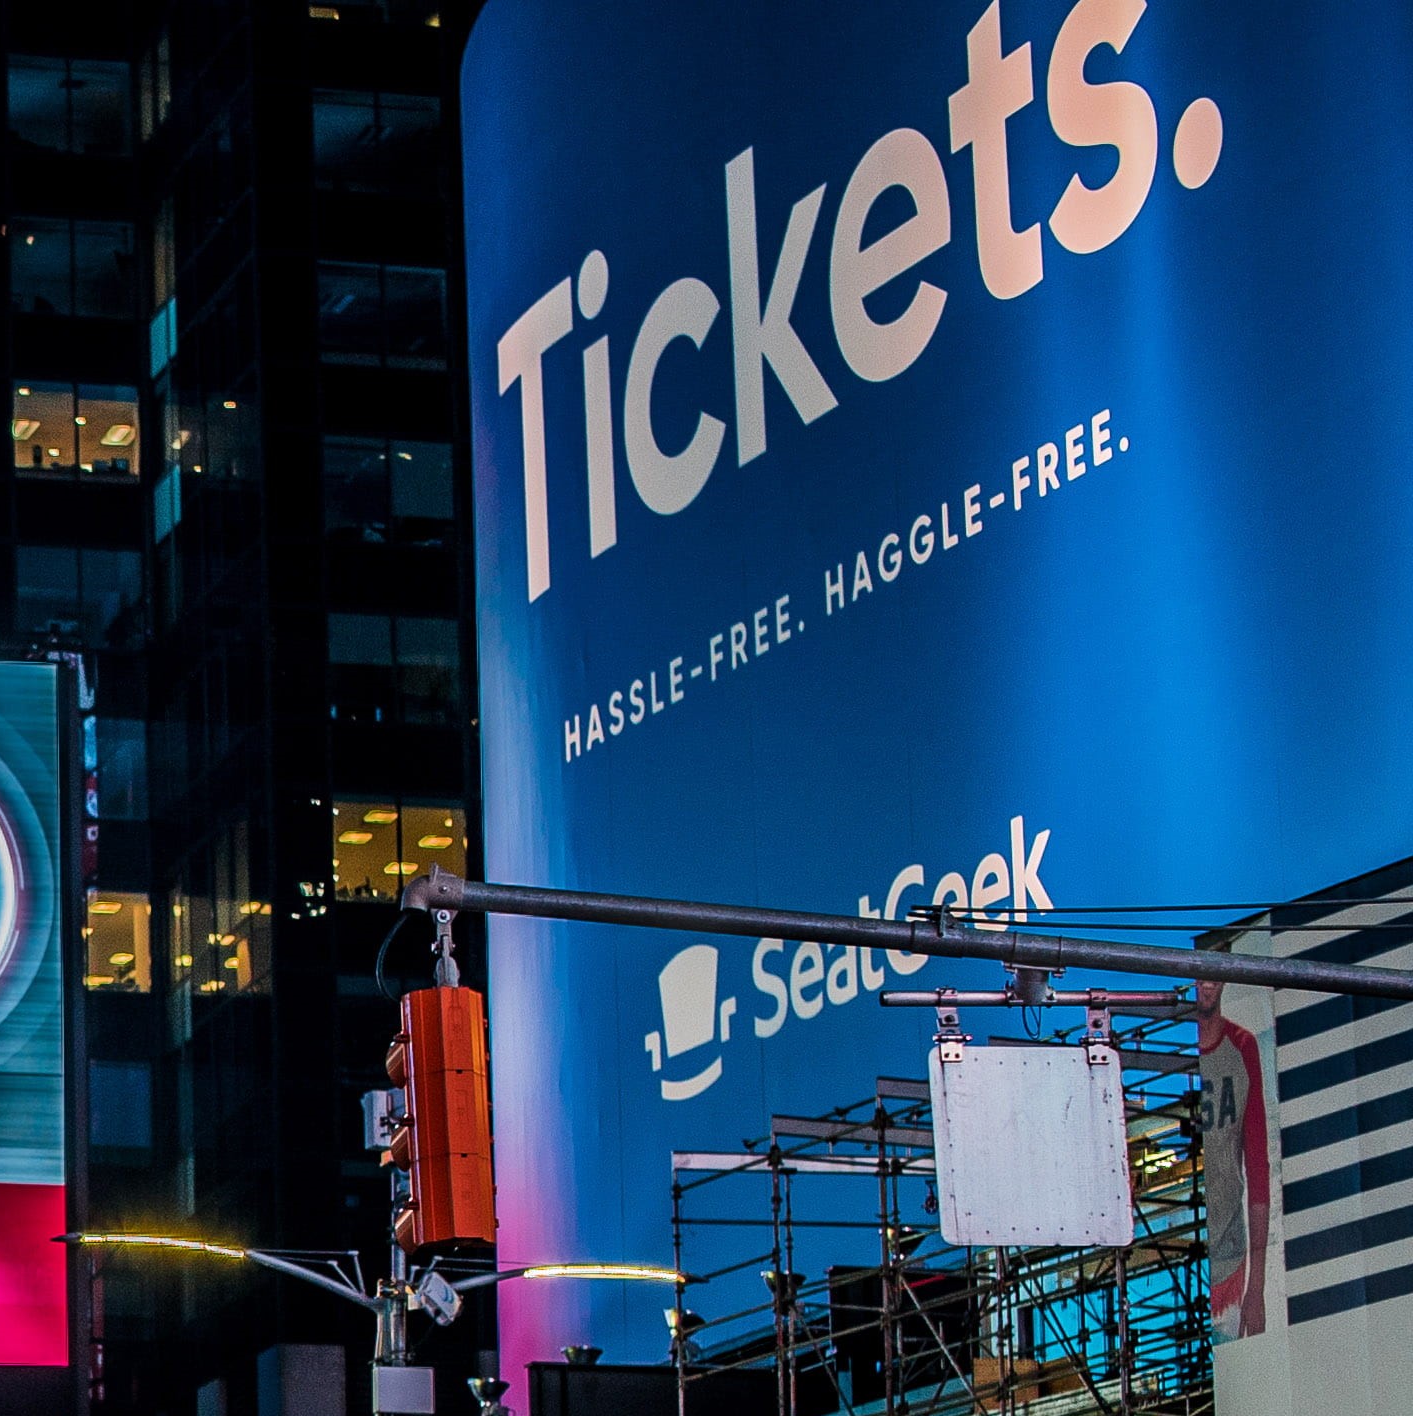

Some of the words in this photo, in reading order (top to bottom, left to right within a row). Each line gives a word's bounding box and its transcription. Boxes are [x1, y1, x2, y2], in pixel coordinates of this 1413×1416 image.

[497, 0, 1224, 603] Tickets.
[563, 593, 806, 763] HASSLE-FREE.
[824, 408, 1130, 615] HAGGLE-FREE.
[751, 814, 1056, 1040] SeatGeek
